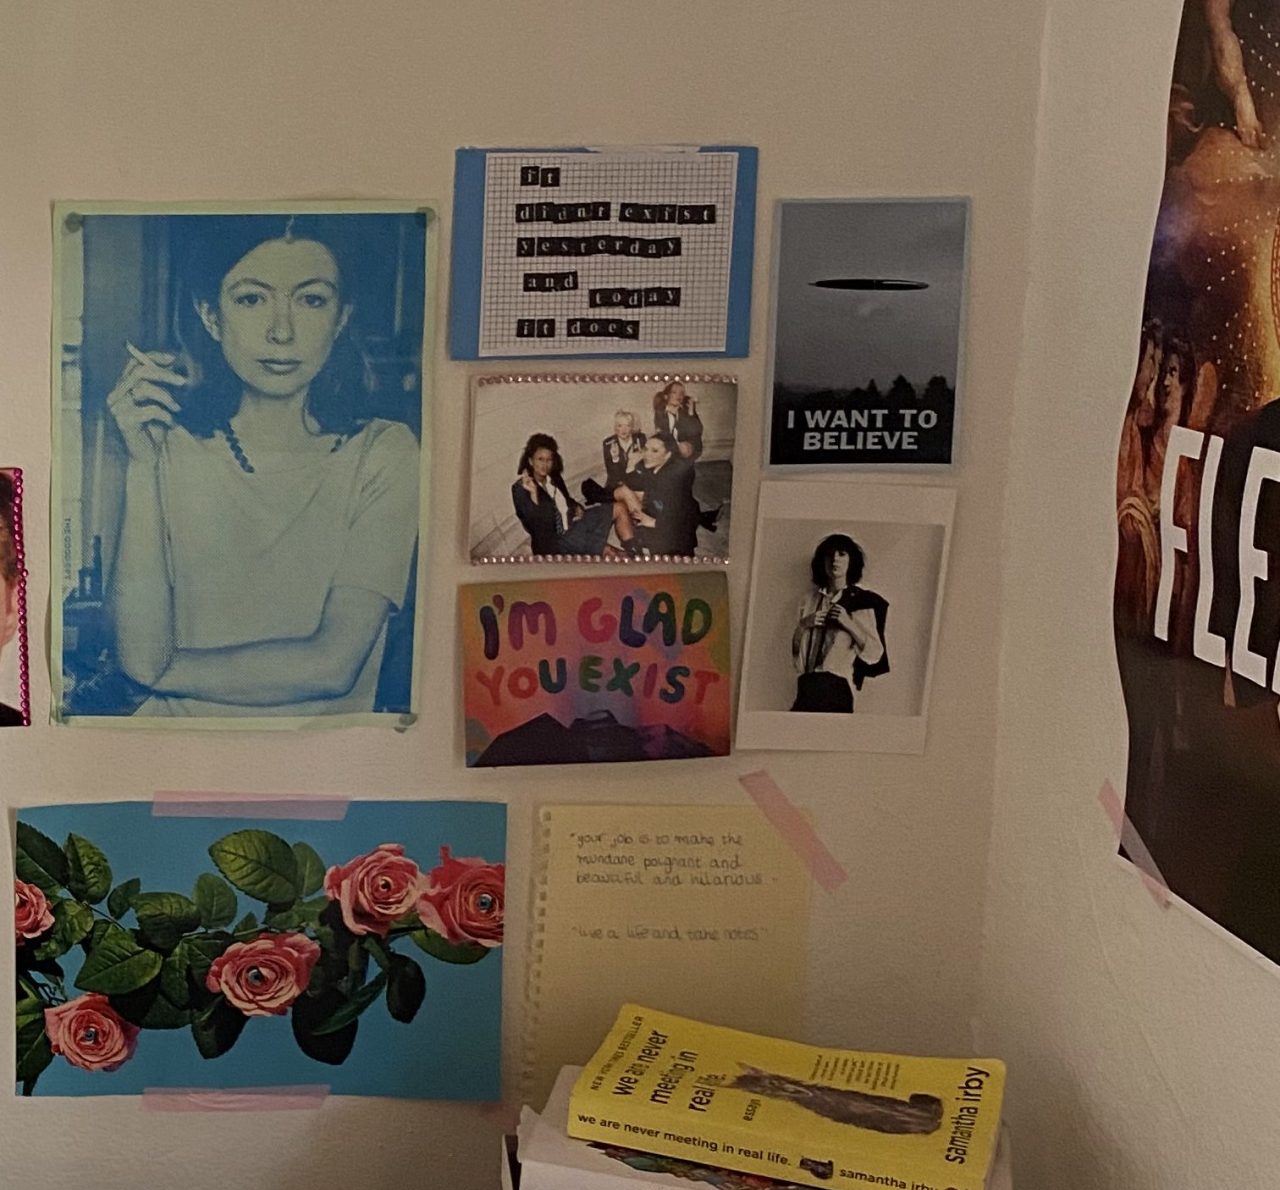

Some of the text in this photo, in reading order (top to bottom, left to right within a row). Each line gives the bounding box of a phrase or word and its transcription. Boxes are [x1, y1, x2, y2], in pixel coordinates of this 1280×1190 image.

[524, 168, 556, 185] it
[519, 204, 711, 222] didnt exist
[519, 237, 677, 256] yesterday
[526, 273, 677, 306] and today
[521, 319, 636, 337] it does
[787, 409, 938, 429] I WANT TO
[803, 431, 918, 451] BELIEVE
[1154, 424, 1280, 700] FLE
[479, 591, 713, 660] I'M GLAD
[476, 655, 721, 706] YOU EXIST
[721, 833, 744, 846] the
[576, 853, 635, 866] mundane
[709, 854, 742, 870] and
[653, 872, 683, 886] and
[652, 927, 681, 941] and
[612, 1075, 639, 1097] we
[639, 1029, 670, 1064] never
[649, 1050, 700, 1105] meeting in
[688, 1081, 716, 1113] real
[944, 1066, 990, 1165] samantha irby
[577, 1113, 596, 1125] we
[599, 1118, 621, 1130] are
[624, 1123, 660, 1138] never
[663, 1131, 718, 1152] meeting
[722, 1143, 735, 1153] in
[738, 1145, 764, 1161] real
[839, 1168, 907, 1190] samantha
